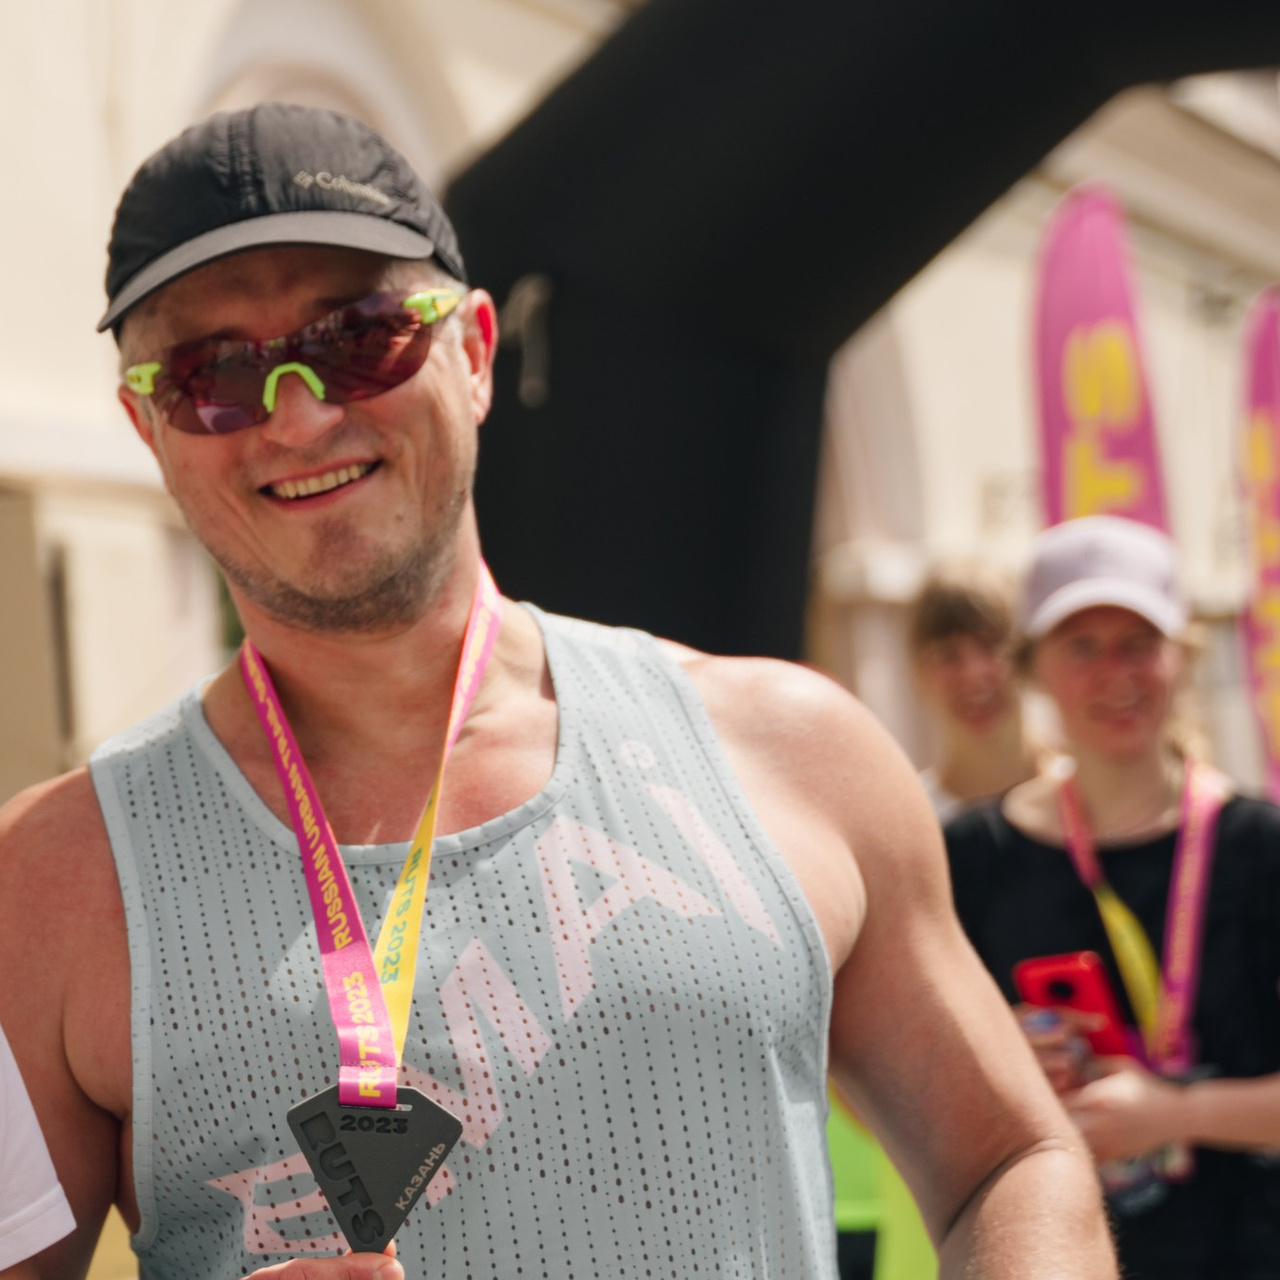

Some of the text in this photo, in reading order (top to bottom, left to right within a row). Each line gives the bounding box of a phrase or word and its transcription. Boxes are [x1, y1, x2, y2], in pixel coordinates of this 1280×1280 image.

[287, 762, 322, 849] URBAN
[311, 846, 353, 951] RUSSIAN
[381, 920, 408, 985] 2023
[342, 971, 383, 1098] RUTS 2023
[339, 1115, 409, 1135] 2023
[299, 1111, 385, 1246] RUTS
[395, 1142, 446, 1211] КАЗАНЬ
